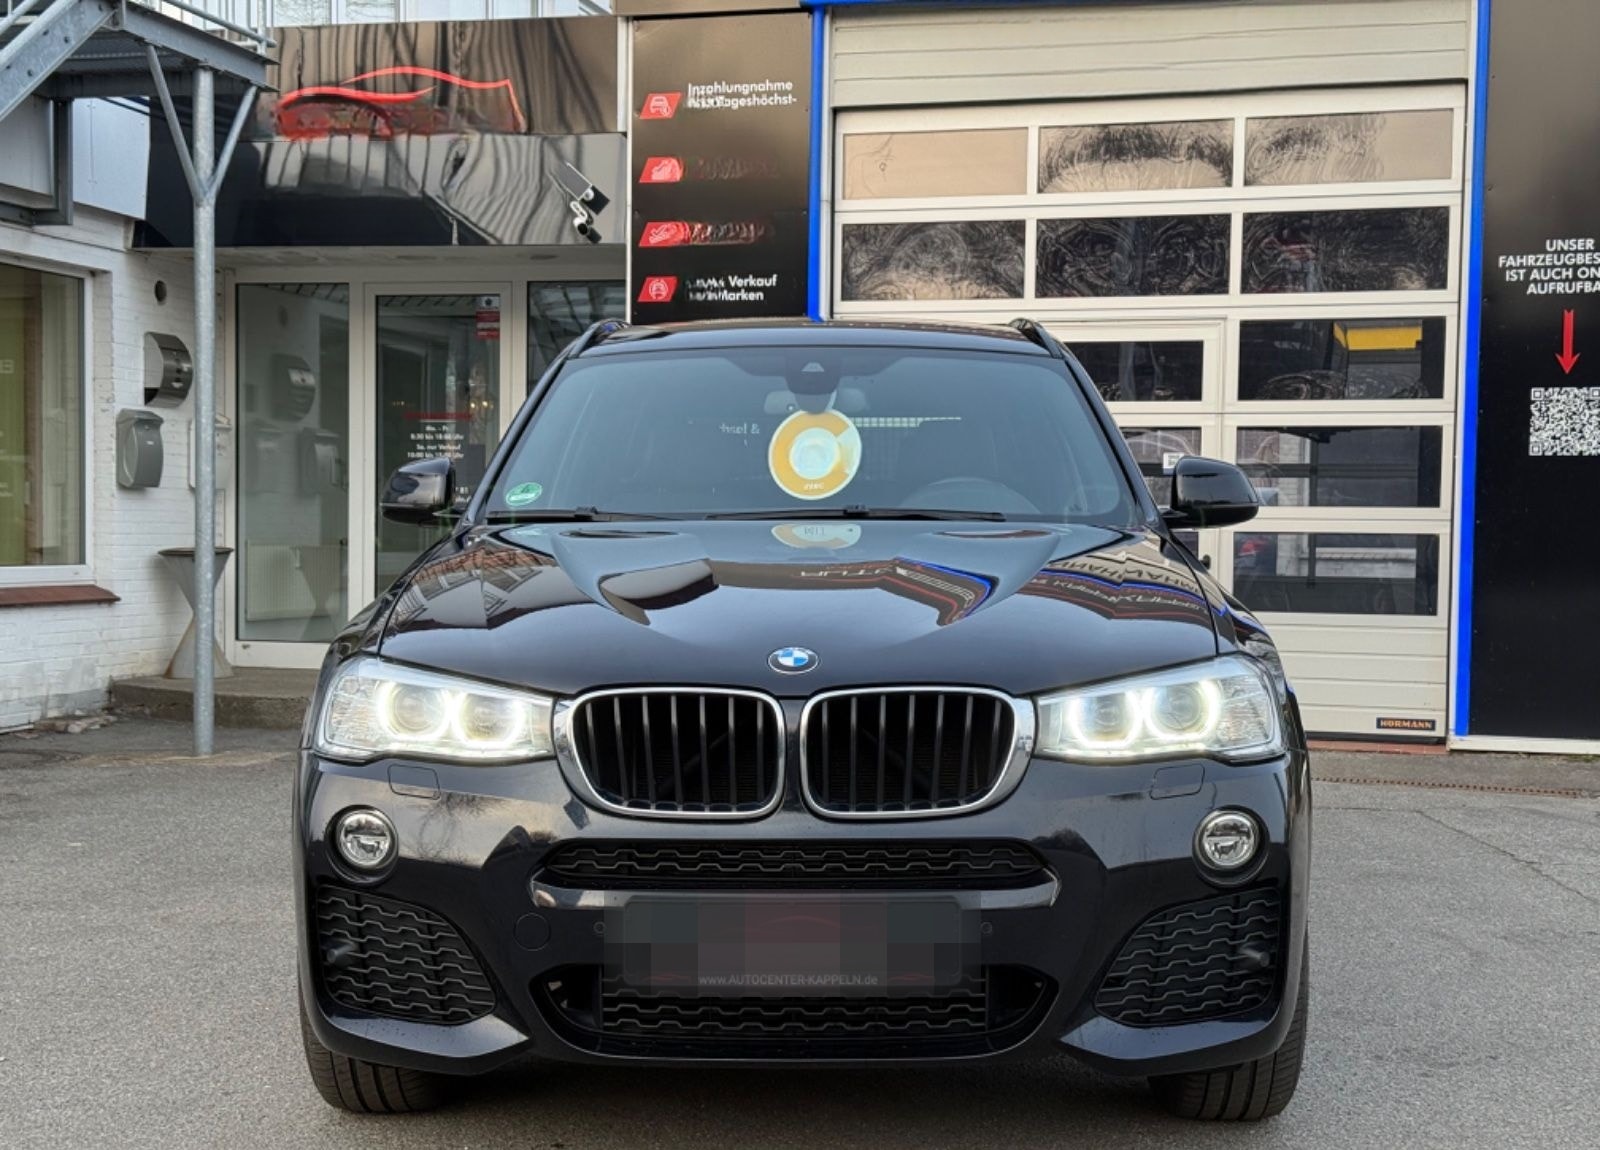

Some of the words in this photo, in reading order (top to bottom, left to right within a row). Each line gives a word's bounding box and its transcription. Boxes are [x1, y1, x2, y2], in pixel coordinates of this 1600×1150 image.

[688, 79, 794, 97] Inzahlungnahme
[1545, 238, 1595, 251] UNSER
[1498, 252, 1600, 268] FAHRZEUGBES
[728, 274, 778, 287] Verkauf
[1505, 269, 1526, 281] IST
[1529, 267, 1573, 280] AUCH
[699, 973, 878, 985] www.AUTOCENTER-KAPPELN.de
